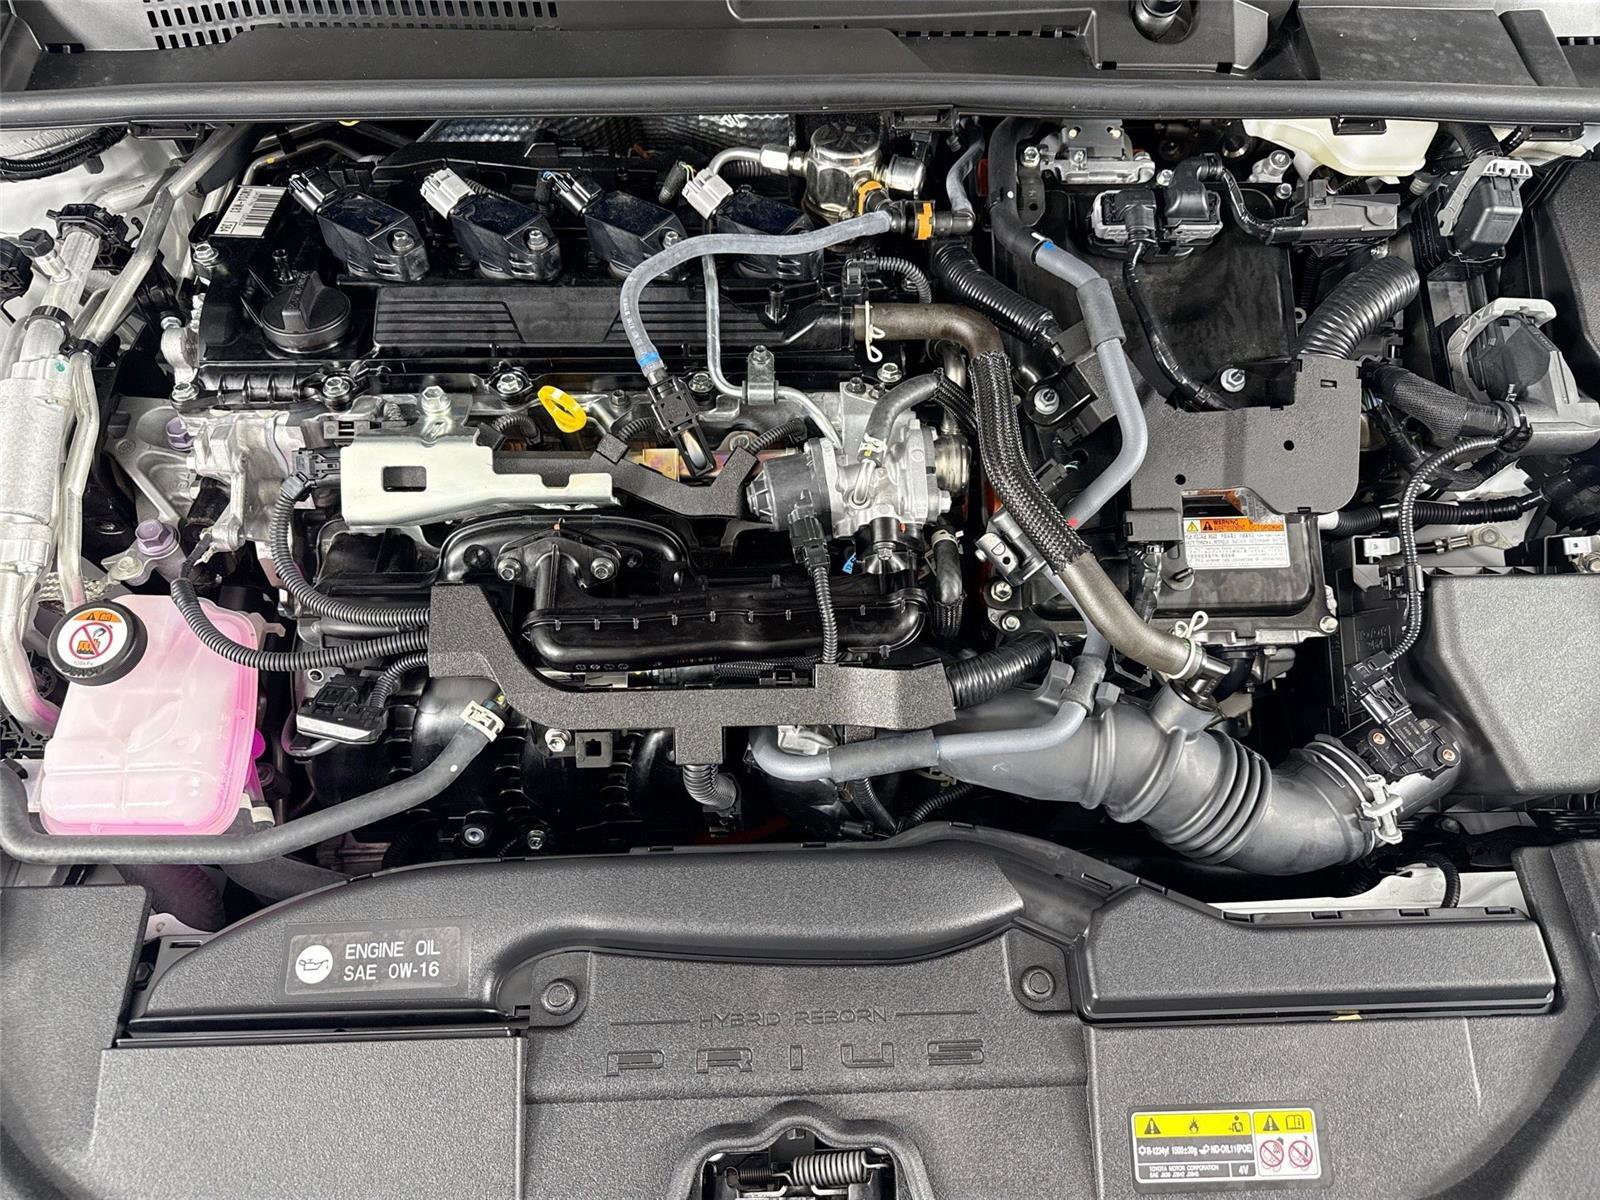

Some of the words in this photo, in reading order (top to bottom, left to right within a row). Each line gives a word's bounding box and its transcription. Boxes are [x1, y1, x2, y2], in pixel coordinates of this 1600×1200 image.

[345, 942, 404, 959] ENGINE
[416, 940, 440, 956] OIL
[343, 965, 377, 981] SAE
[388, 961, 440, 979] 0W-16
[700, 1011, 781, 1028] HYBRID
[795, 1008, 887, 1025] REBORN
[606, 1038, 985, 1077] PRIUS
